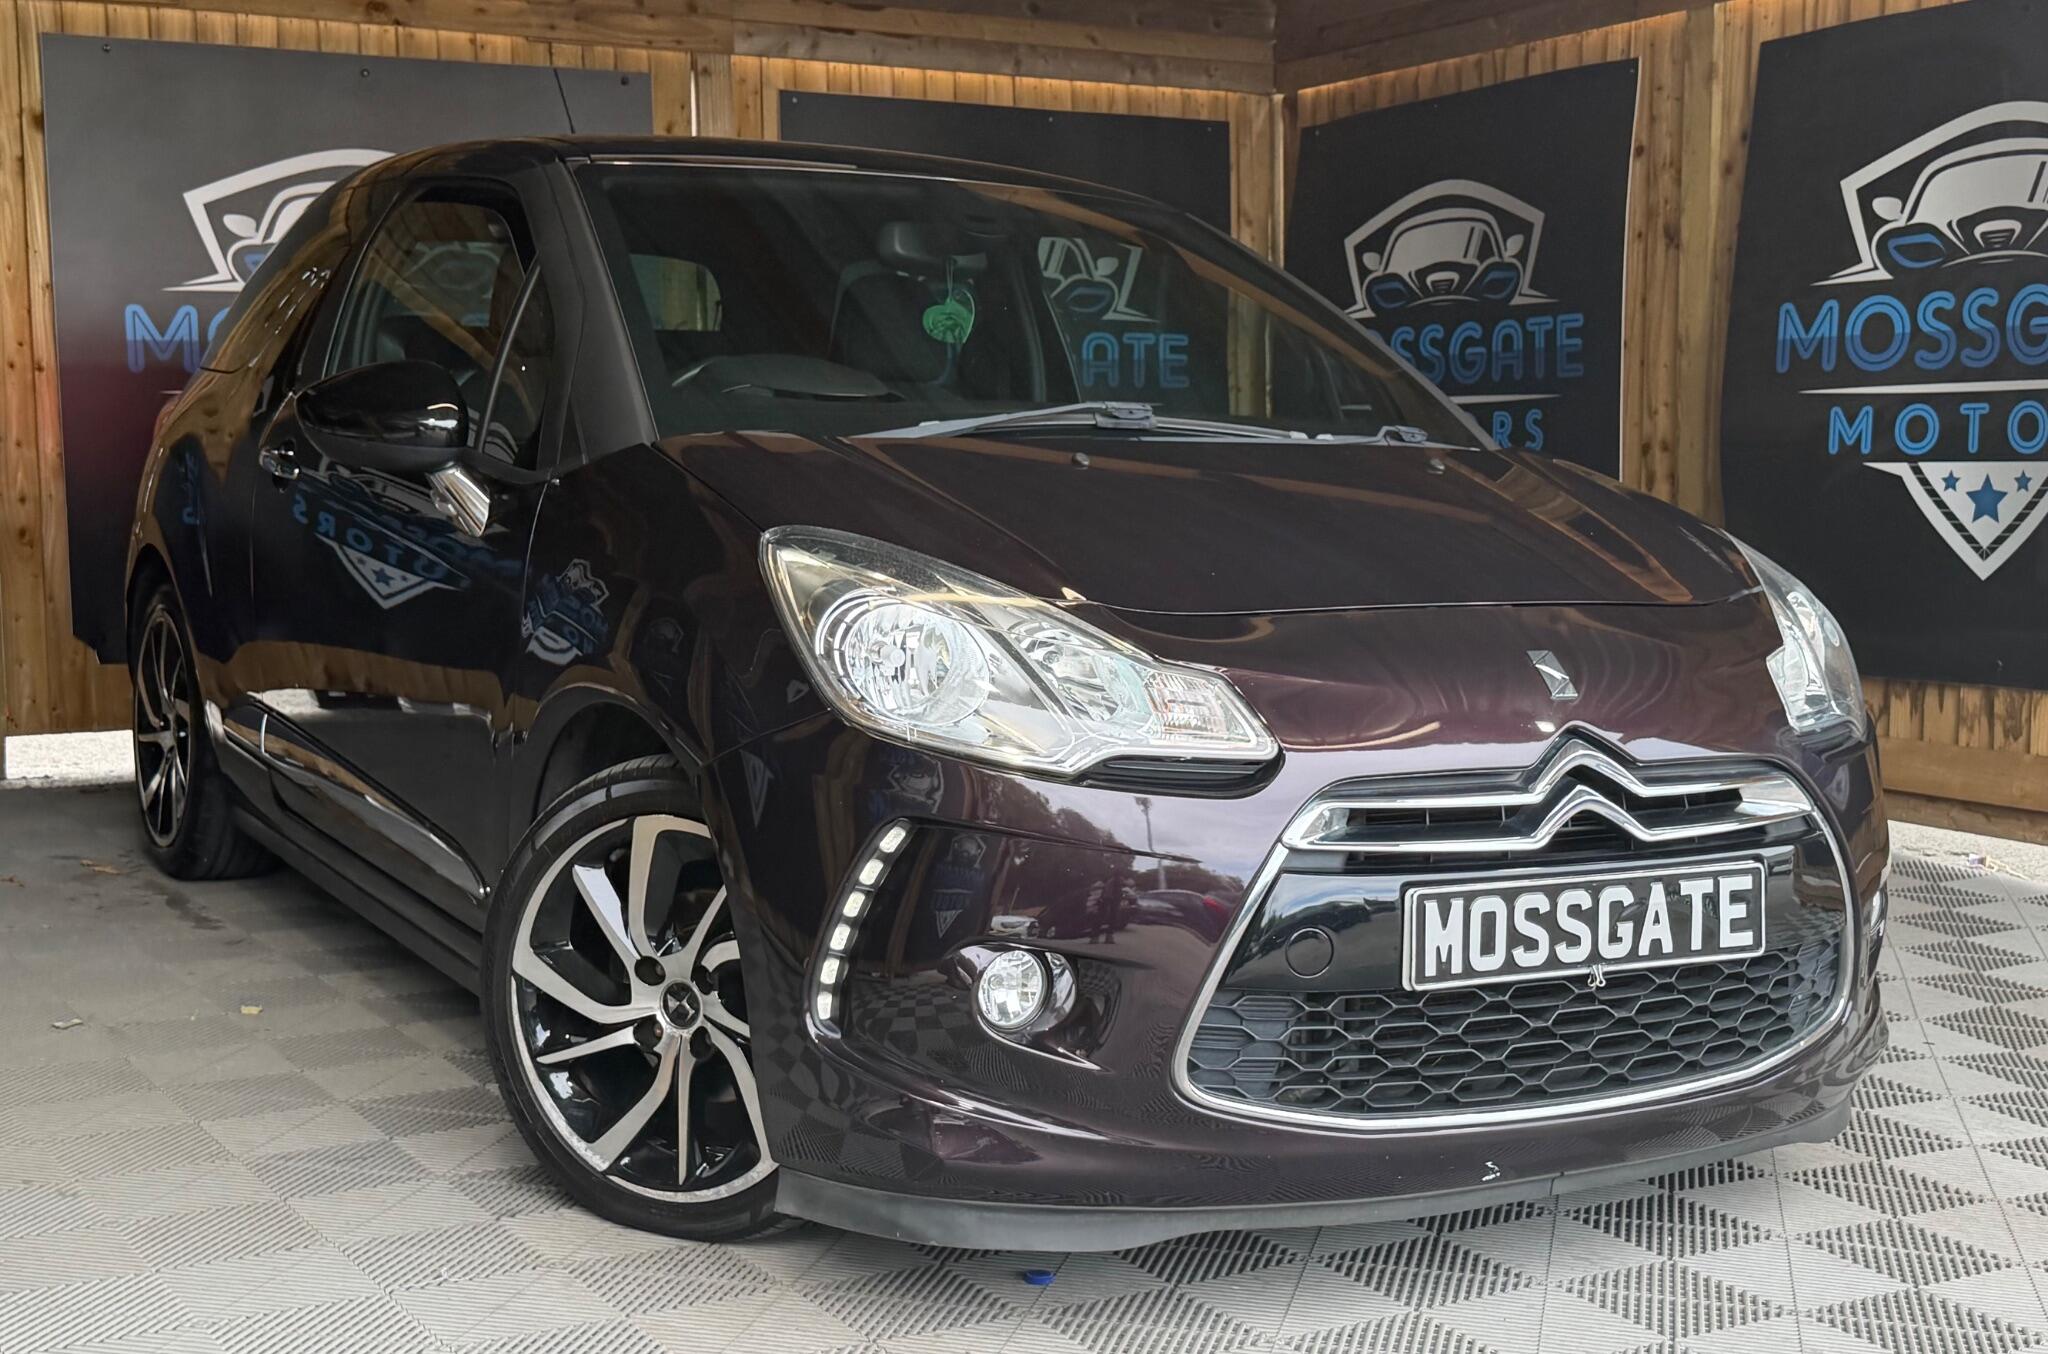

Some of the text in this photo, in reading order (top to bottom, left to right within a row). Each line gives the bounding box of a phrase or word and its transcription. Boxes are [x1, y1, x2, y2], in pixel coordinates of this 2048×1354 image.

[1366, 313, 1584, 386] SSGATE
[1466, 408, 1543, 450] RS
[1423, 874, 1754, 978] MOSSGATE
